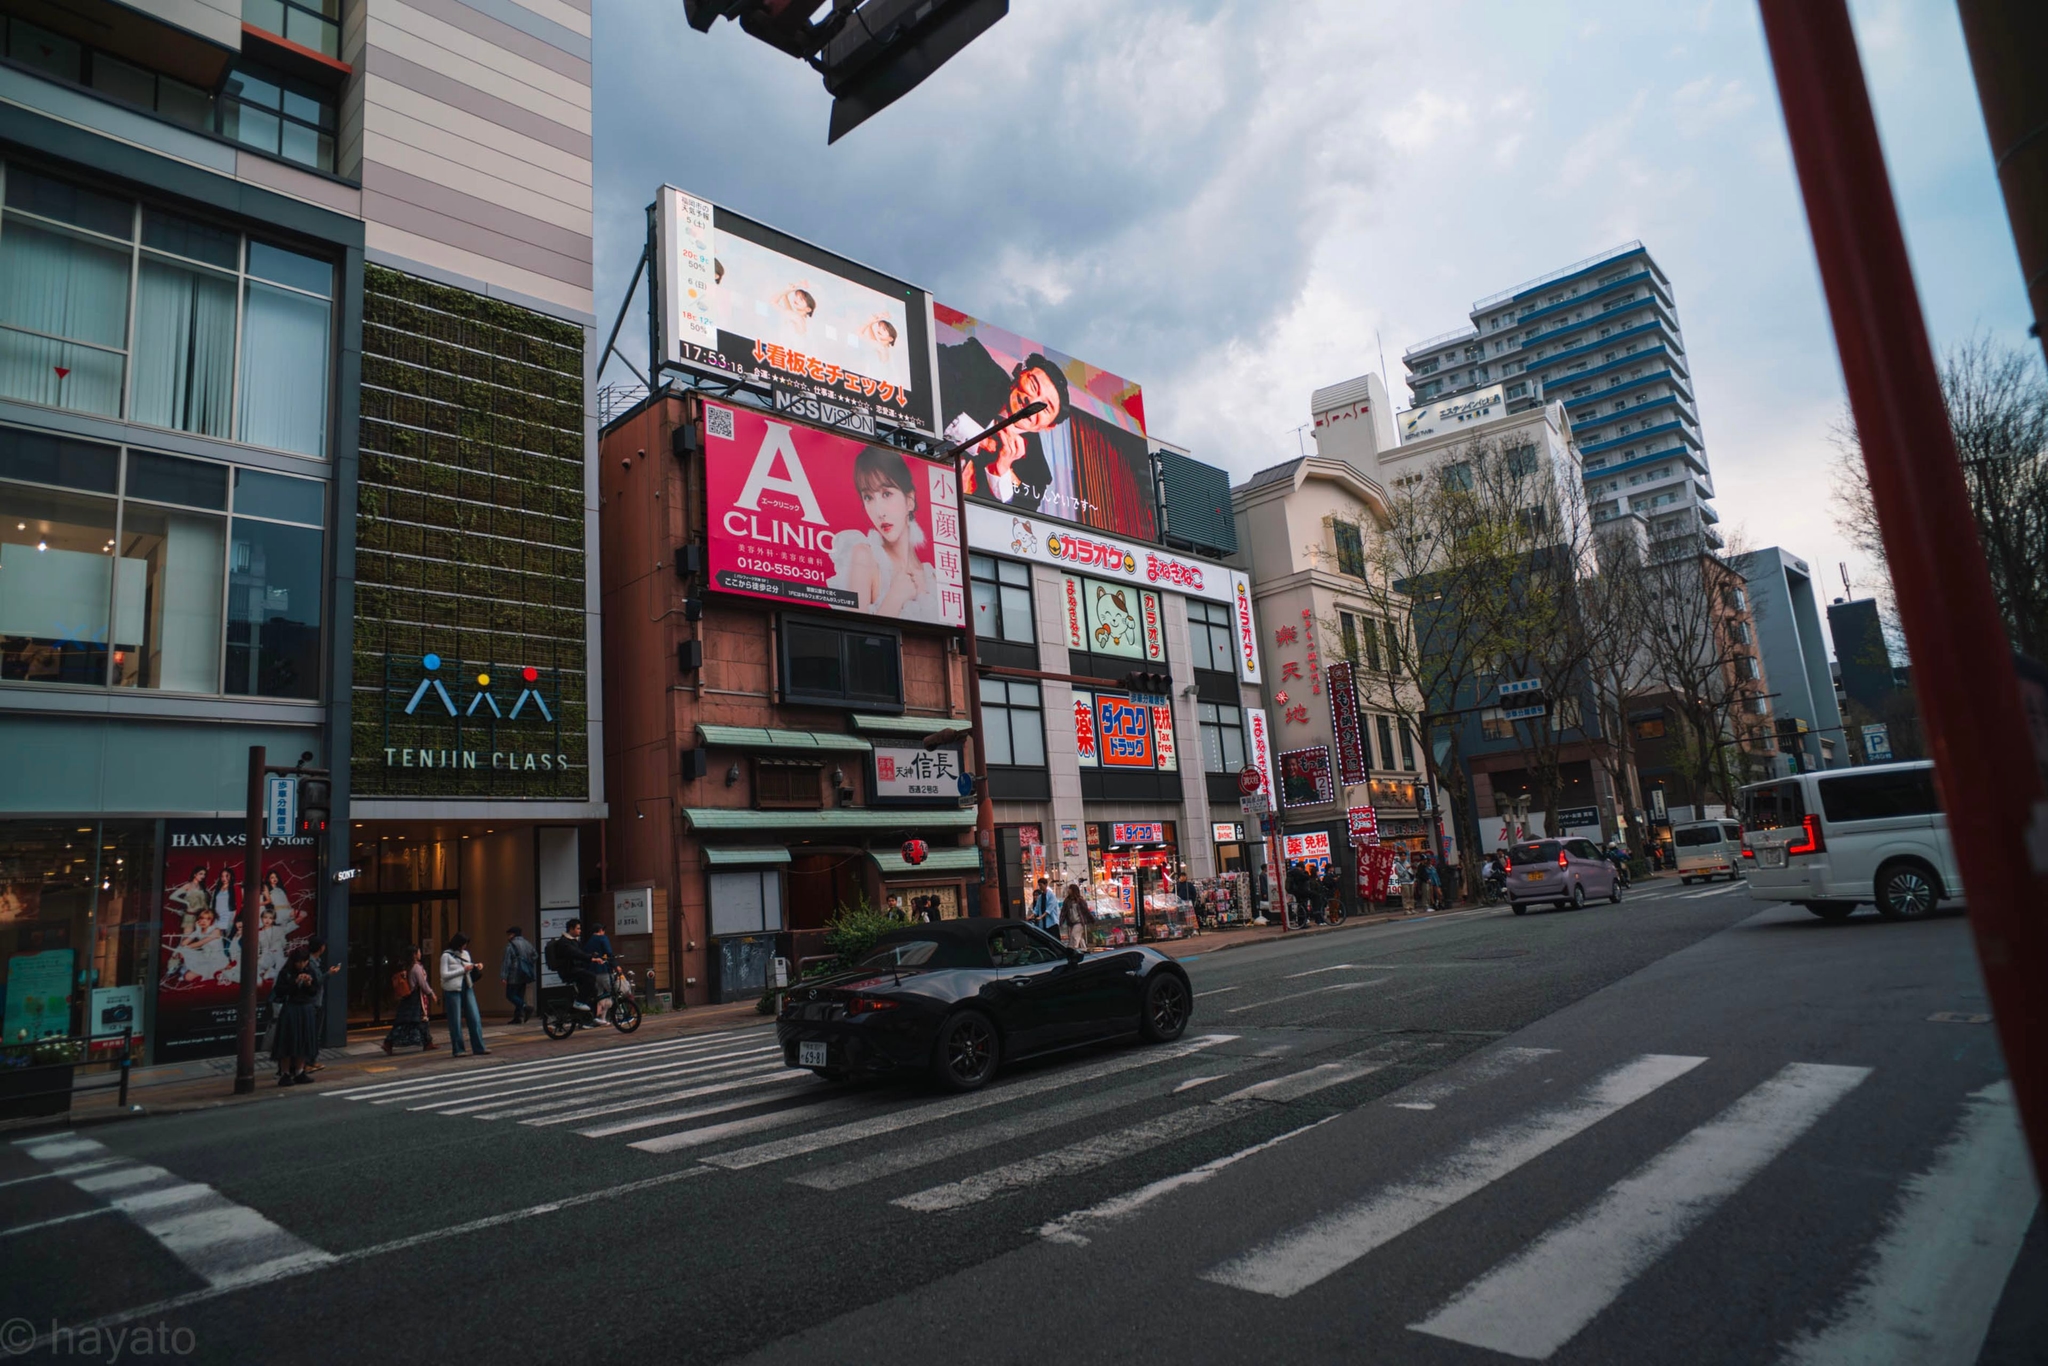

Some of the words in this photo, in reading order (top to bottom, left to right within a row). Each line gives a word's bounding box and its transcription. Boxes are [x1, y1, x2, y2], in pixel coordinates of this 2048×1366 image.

[681, 204, 710, 221] 天気予報
[686, 216, 692, 224] 5
[693, 221, 706, 230] (土)
[688, 261, 706, 273] 50%
[694, 280, 707, 291] (日)
[689, 322, 707, 335] 50%
[683, 343, 744, 374] 17:53:18
[766, 342, 895, 403] 看板をチェック
[775, 390, 820, 420] NSS
[1420, 427, 1435, 436] TWIN
[733, 420, 830, 527] A
[760, 497, 800, 512] エークリニック
[723, 510, 836, 554] CLINIC
[932, 473, 964, 620] 小顔専門
[737, 556, 826, 582] 0120-550-301
[1060, 535, 1123, 570] カラオケ
[1146, 554, 1205, 591] まねきねこ
[724, 577, 780, 594] ここから徒歩2分
[1065, 578, 1081, 647] まねきねこ
[1144, 594, 1160, 658] カラオケ
[1237, 595, 1253, 658] カラオケ
[1130, 693, 1166, 706] 歩車分離信号
[1101, 703, 1147, 736] ダイコク
[1152, 703, 1172, 731] 免税
[1074, 699, 1096, 758] 薬
[1157, 730, 1170, 742] Tax
[1109, 737, 1145, 757] ドラッグ
[1157, 744, 1173, 753] Free
[1870, 735, 1884, 751] P
[384, 748, 477, 769] TENJIN
[492, 752, 569, 770] CLASS
[895, 766, 914, 778] 天神
[911, 752, 958, 780] 信長
[1299, 757, 1328, 773] もつ鍋
[1243, 775, 1260, 786] 消火栓
[277, 780, 288, 834] 歩車分離信号
[277, 836, 314, 846] Store
[1125, 826, 1152, 840] ダイコク
[1287, 836, 1302, 855] 薬
[1304, 833, 1328, 849] 免税
[338, 869, 355, 881] SONY
[805, 1051, 824, 1064] 69-81
